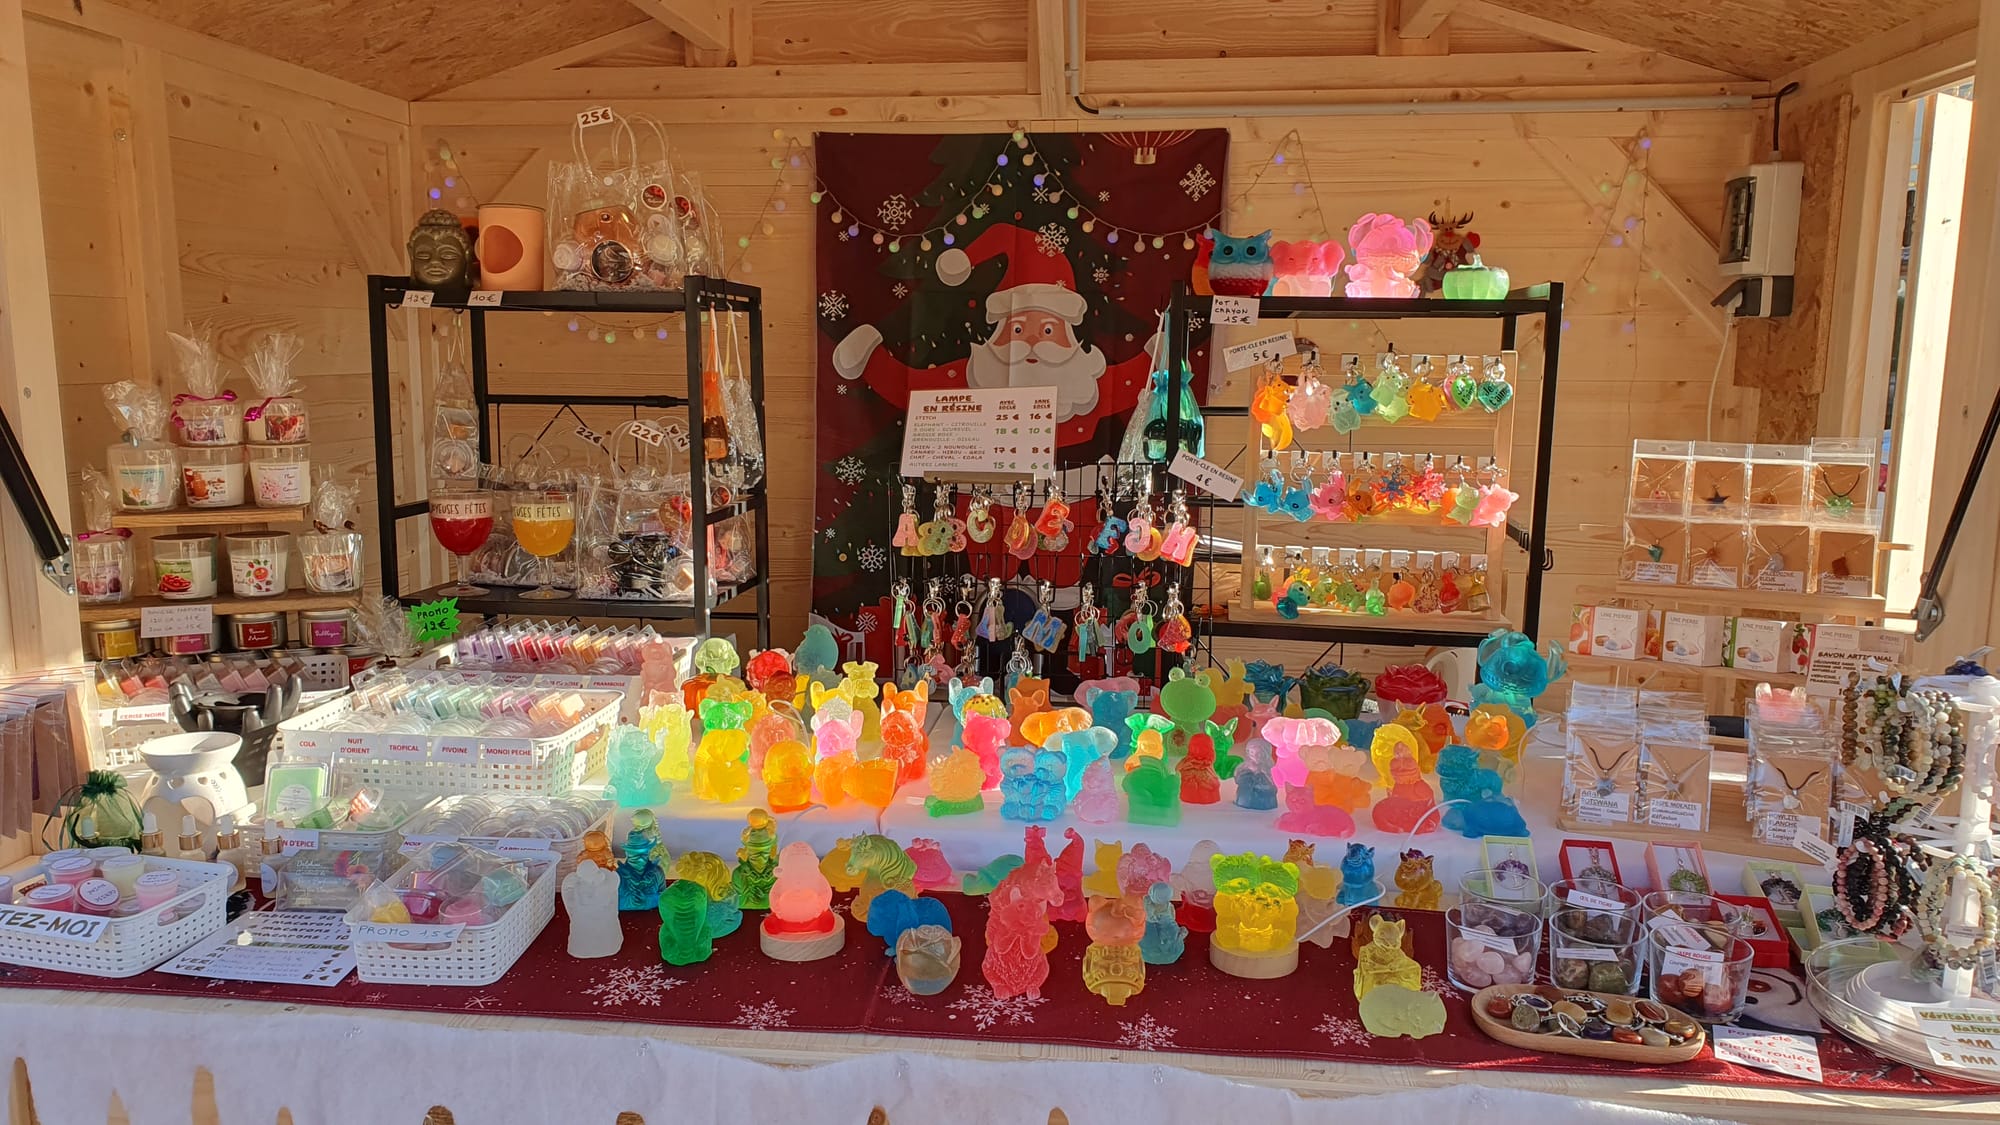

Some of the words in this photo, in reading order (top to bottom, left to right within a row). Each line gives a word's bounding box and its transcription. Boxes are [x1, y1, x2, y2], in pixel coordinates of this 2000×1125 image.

[580, 109, 611, 125] 25€
[472, 293, 496, 303] 10€
[1258, 339, 1268, 347] EN
[942, 403, 983, 412] RÉSINE
[576, 427, 602, 444] 22€
[631, 425, 660, 443] 22€
[417, 607, 449, 619] PROMO
[1818, 651, 1845, 659] SAVON
[299, 740, 316, 748] COLA
[389, 744, 420, 752] TROPICAL
[340, 746, 370, 754] D'ORIENT
[441, 746, 468, 754] PIVOINE
[486, 748, 510, 756] MONOI
[511, 749, 532, 757] PECHE
[289, 840, 315, 848] D'EPICE
[358, 925, 410, 937] PROMO
[1919, 1011, 1992, 1022] Véritables
[1719, 1041, 1763, 1054] Pierre
[1767, 1049, 1816, 1064] roulée
[1960, 1054, 1998, 1066] MM
